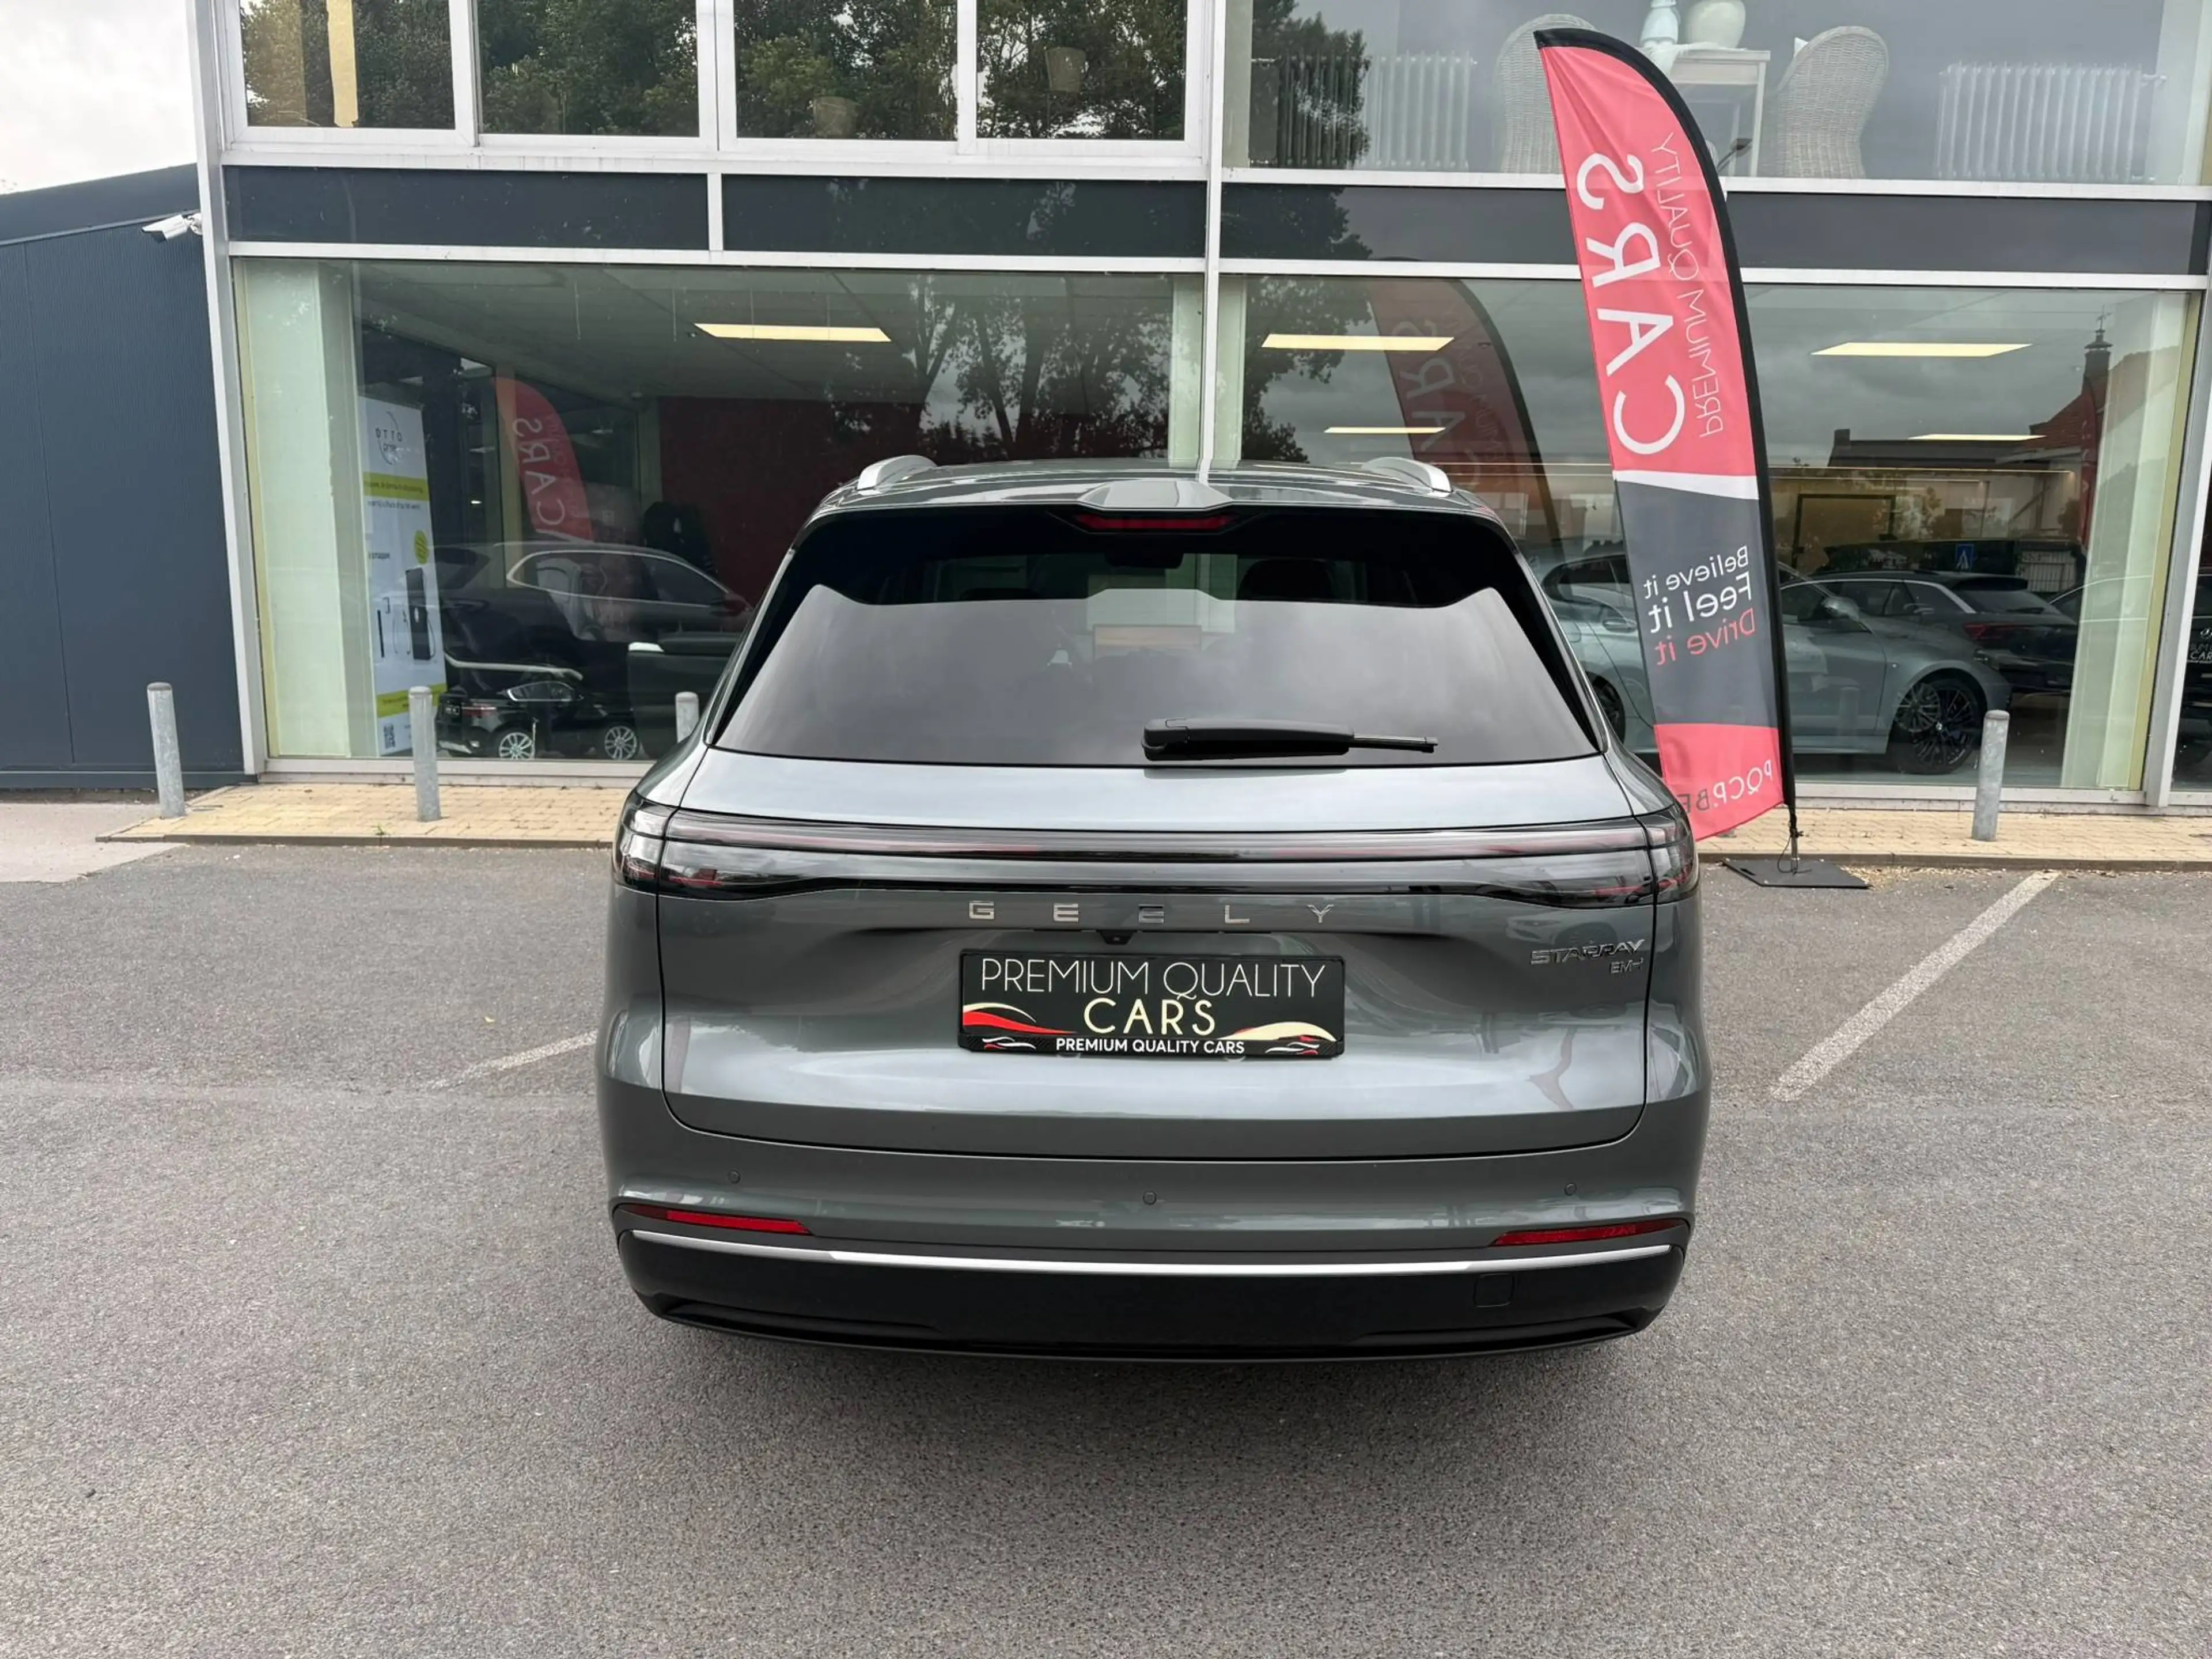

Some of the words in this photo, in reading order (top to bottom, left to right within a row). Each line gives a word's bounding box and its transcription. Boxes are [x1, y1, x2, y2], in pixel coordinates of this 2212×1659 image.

[968, 900, 1335, 924] GEELY
[1531, 939, 1646, 966] STARRAY
[981, 958, 1149, 995] PREMIUM
[1162, 960, 1326, 1001] QUALITY
[1083, 997, 1217, 1036] CARS
[1056, 1037, 1129, 1053] PREMIUM
[1132, 1039, 1200, 1055] QUALITY
[1202, 1039, 1245, 1055] CARS
